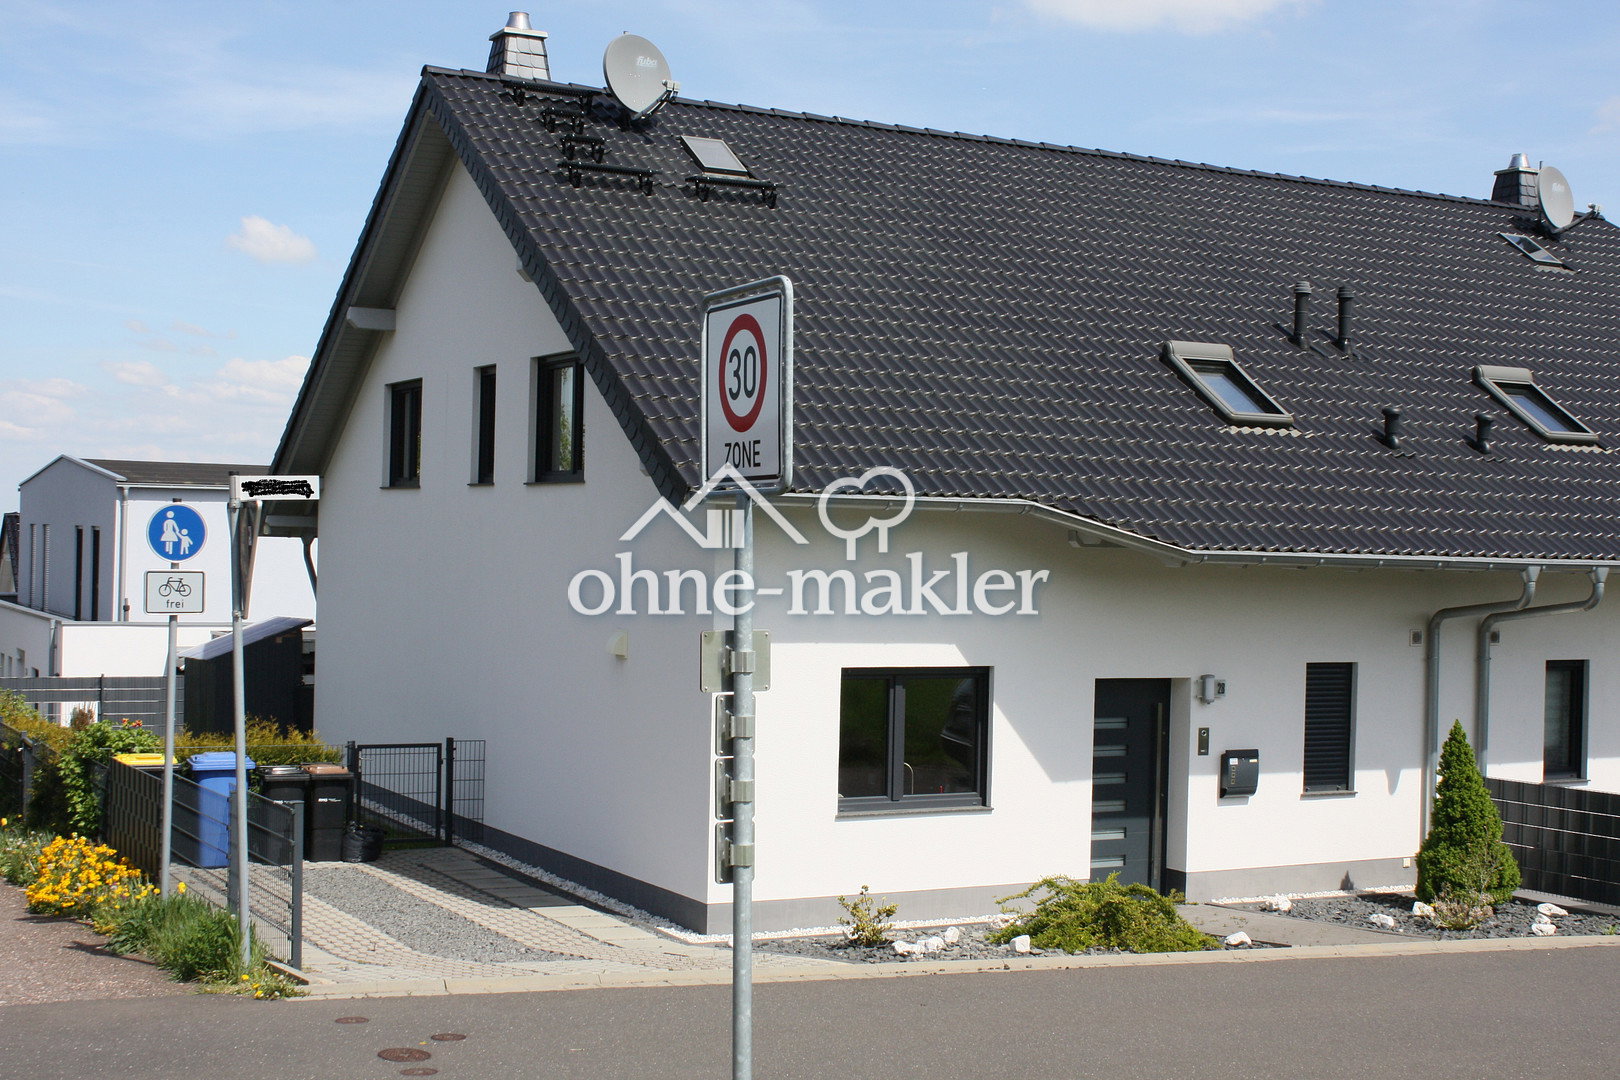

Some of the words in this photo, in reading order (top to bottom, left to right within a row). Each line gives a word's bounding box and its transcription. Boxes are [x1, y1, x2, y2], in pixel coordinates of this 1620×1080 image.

[728, 345, 757, 401] 30
[724, 439, 762, 469] ZONE
[166, 599, 184, 609] frei
